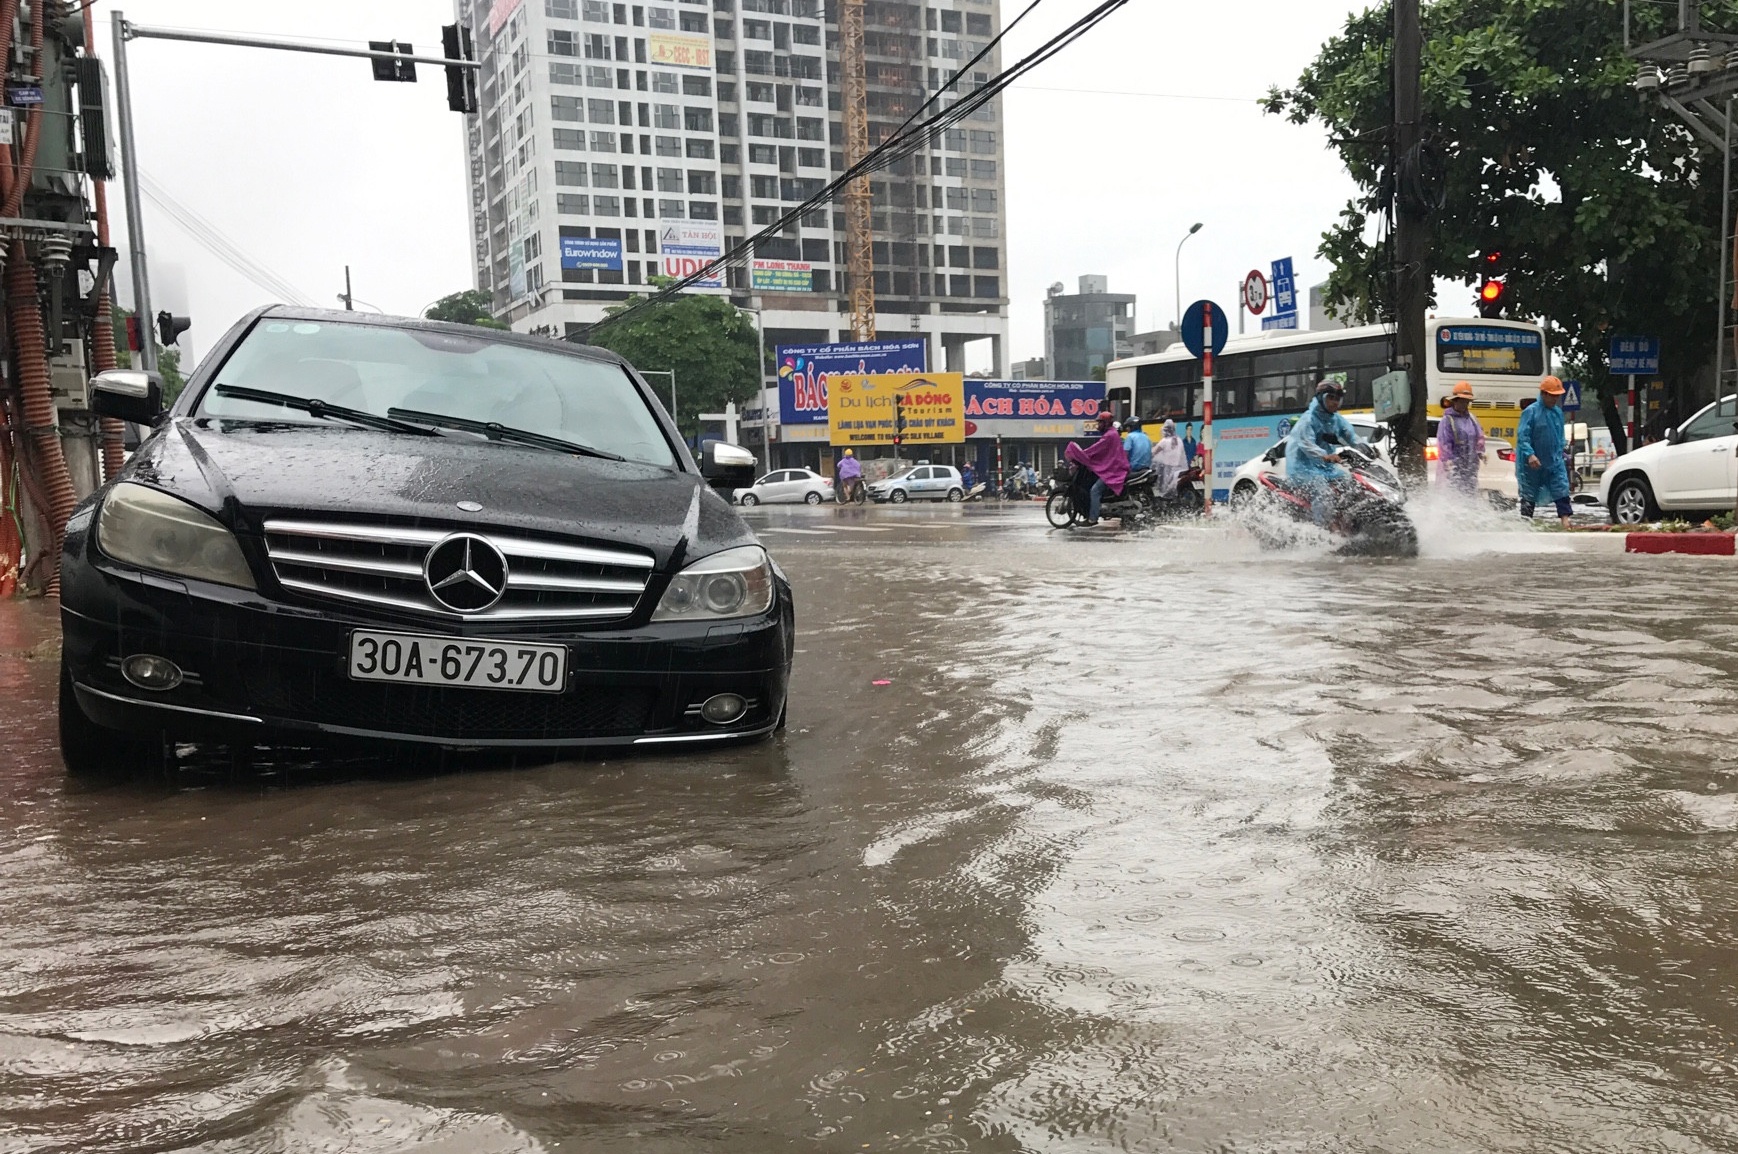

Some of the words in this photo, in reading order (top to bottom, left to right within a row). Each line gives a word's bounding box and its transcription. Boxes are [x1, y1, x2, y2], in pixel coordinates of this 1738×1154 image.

[682, 231, 699, 239] TÂN
[701, 231, 717, 240] HỘI
[564, 247, 618, 258] Eurowindow
[783, 347, 805, 355] CÔNG
[858, 343, 881, 352] BÁCH
[902, 342, 920, 350] SƠN
[840, 397, 860, 408] Du
[866, 395, 892, 408] lịch
[897, 392, 914, 406] À
[915, 391, 952, 406] ĐÔNG
[963, 394, 1014, 415] ÁCH
[1018, 394, 1066, 415] HÓA
[849, 433, 876, 441] WELCOME
[923, 432, 945, 440] VILLAGE
[356, 637, 559, 686] 30A-673.70
